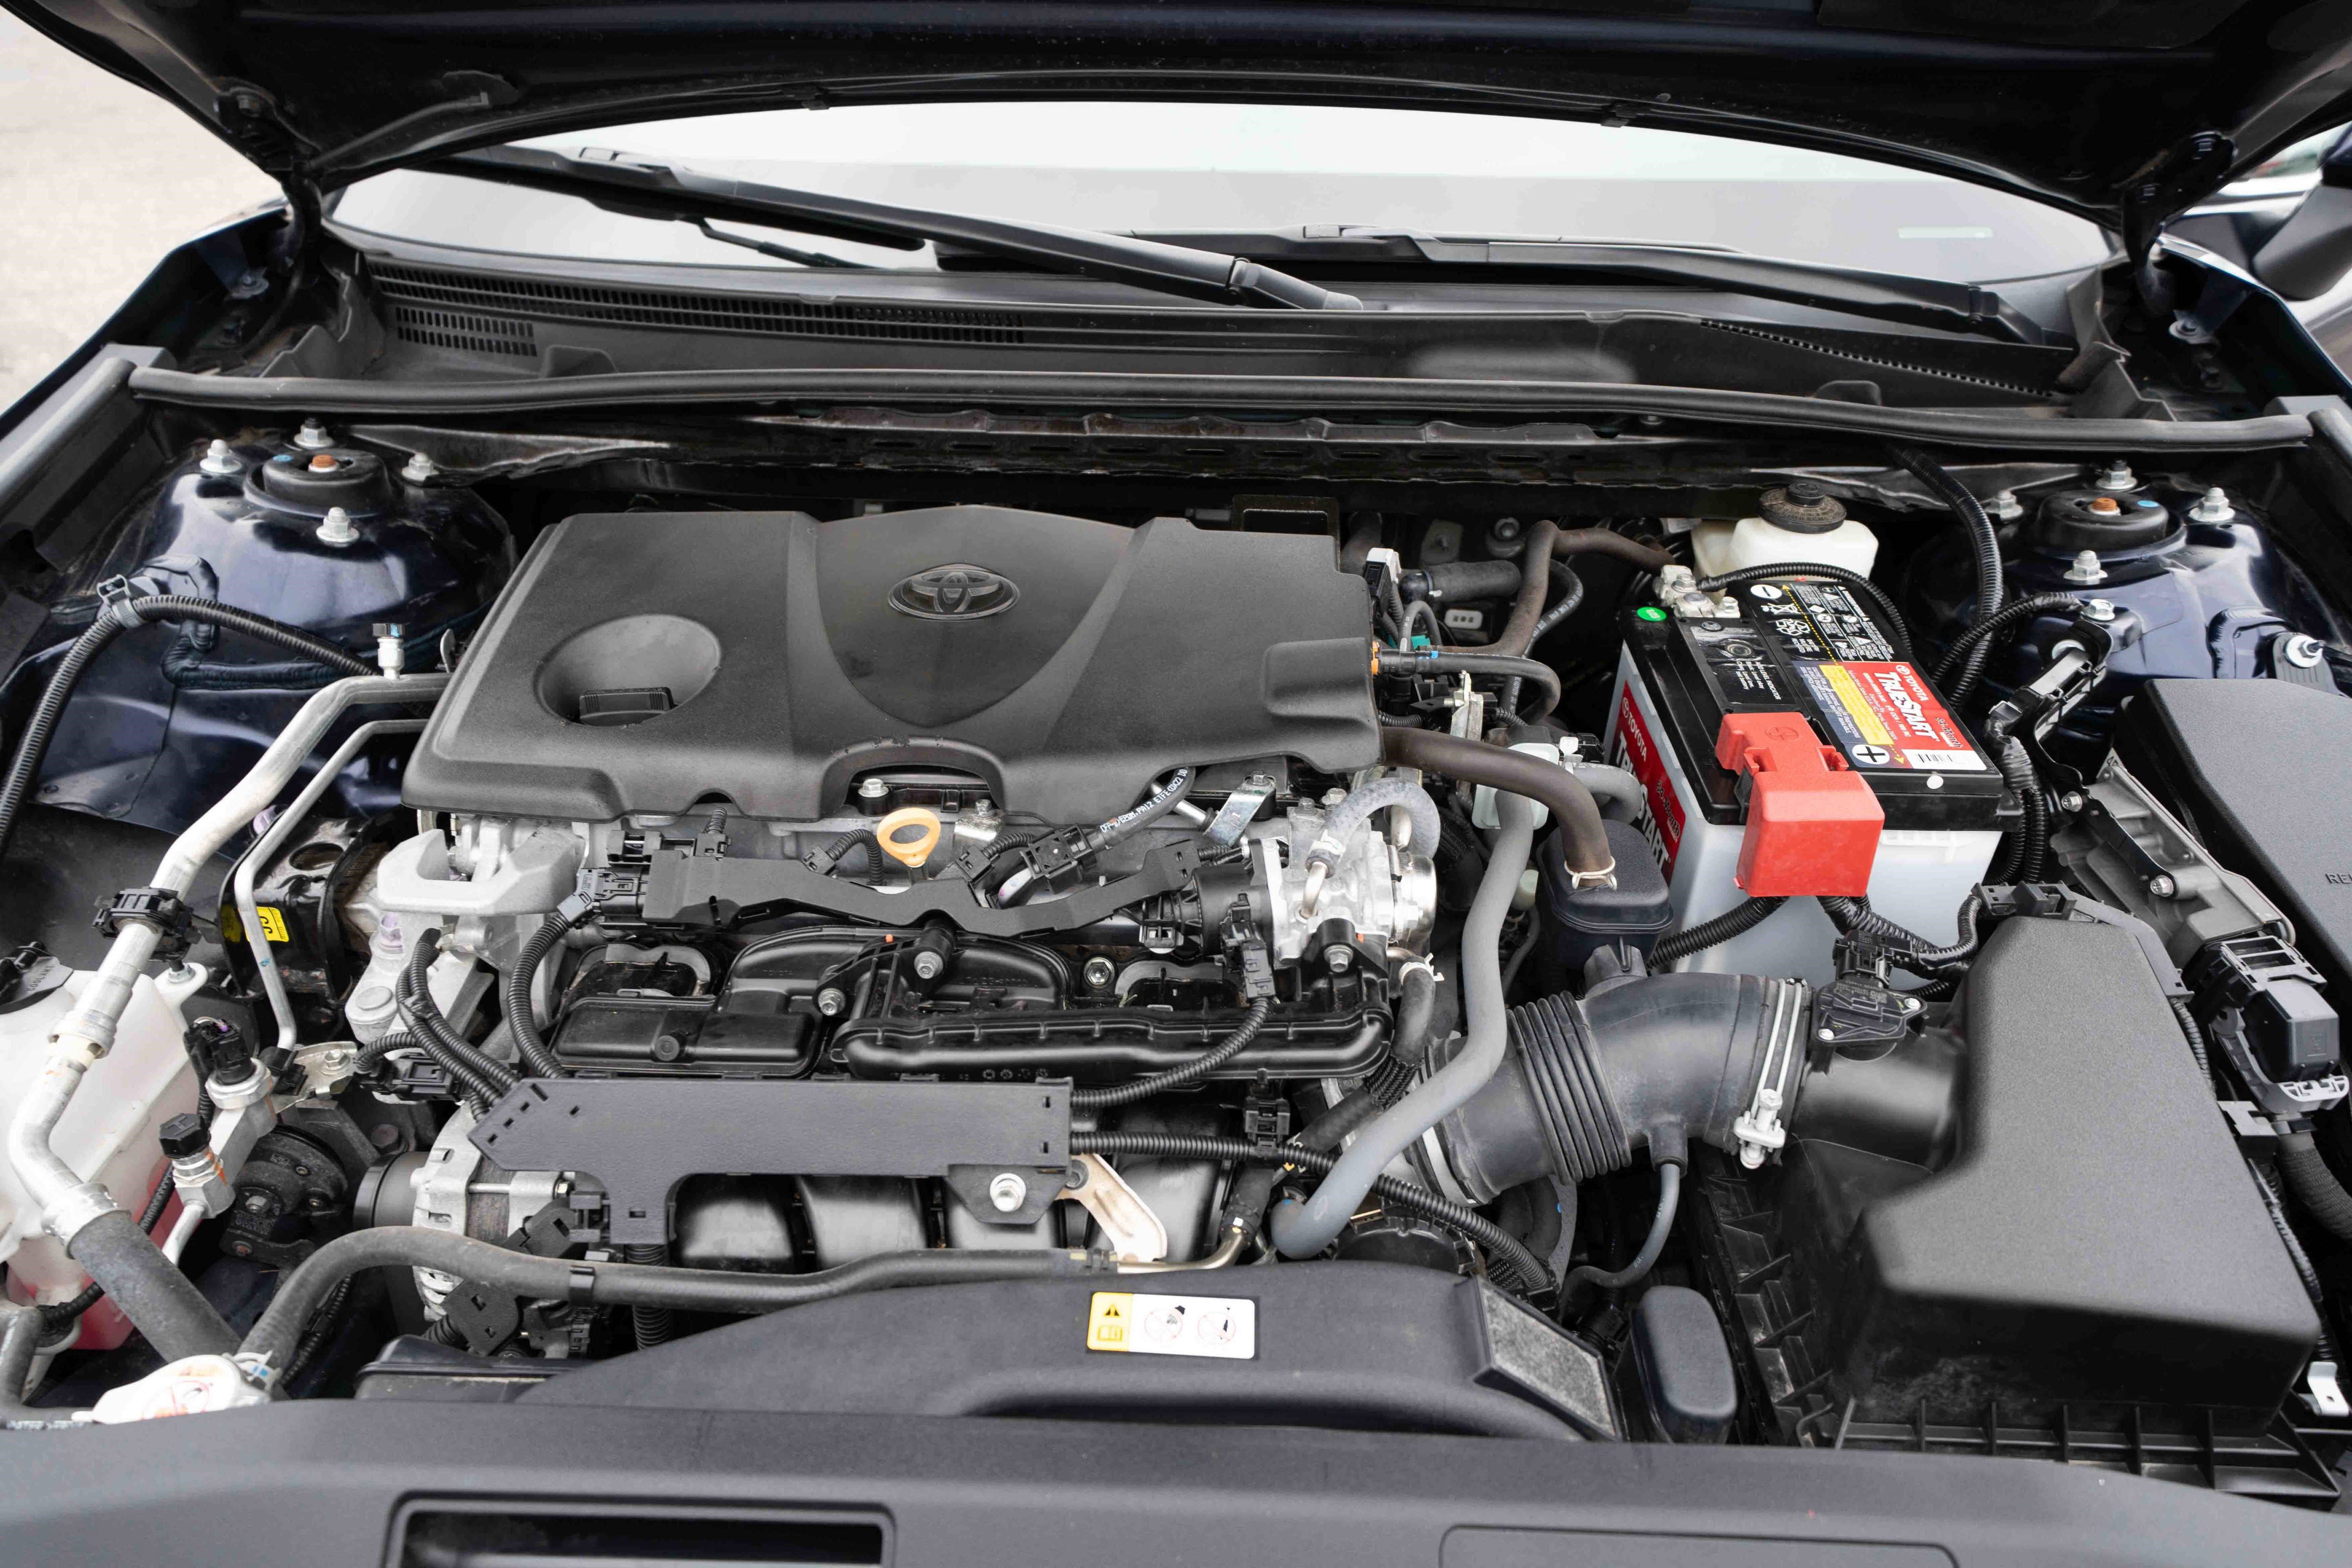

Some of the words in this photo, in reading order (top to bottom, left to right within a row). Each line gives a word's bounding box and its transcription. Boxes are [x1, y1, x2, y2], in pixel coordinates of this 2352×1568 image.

[1737, 677, 1750, 689] battery
[1759, 670, 1770, 679] LEVEL
[1765, 680, 1782, 699] INDICATOR
[1904, 675, 1929, 701] TOYOTA
[1628, 711, 1647, 762] TOYOTA
[2325, 873, 2352, 884] RE
